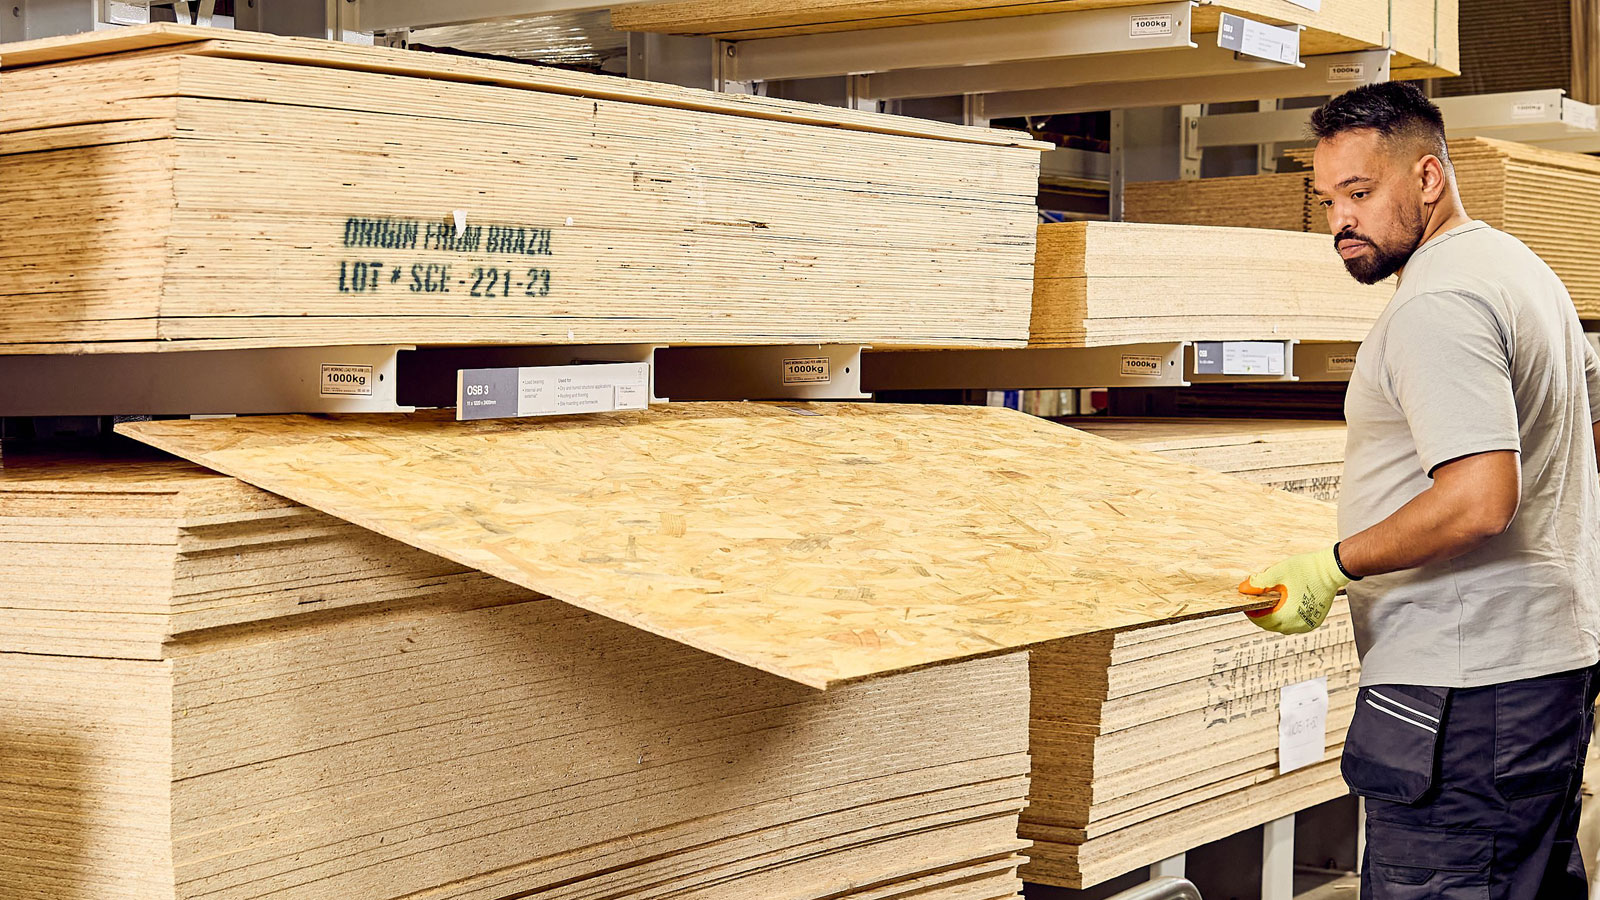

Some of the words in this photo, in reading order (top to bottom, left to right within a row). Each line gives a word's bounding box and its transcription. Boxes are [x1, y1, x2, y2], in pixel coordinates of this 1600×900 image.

[1136, 20, 1167, 28] 1000kg
[344, 217, 418, 250] ORIGIN
[424, 221, 482, 252] FROM
[486, 224, 552, 255] BRAZIL
[339, 261, 383, 292] LOT
[788, 365, 824, 374] 1000kg
[1126, 360, 1157, 369] 1000kg
[327, 373, 366, 386] 1000kg
[467, 385, 483, 396] OSB
[484, 385, 489, 395] 3
